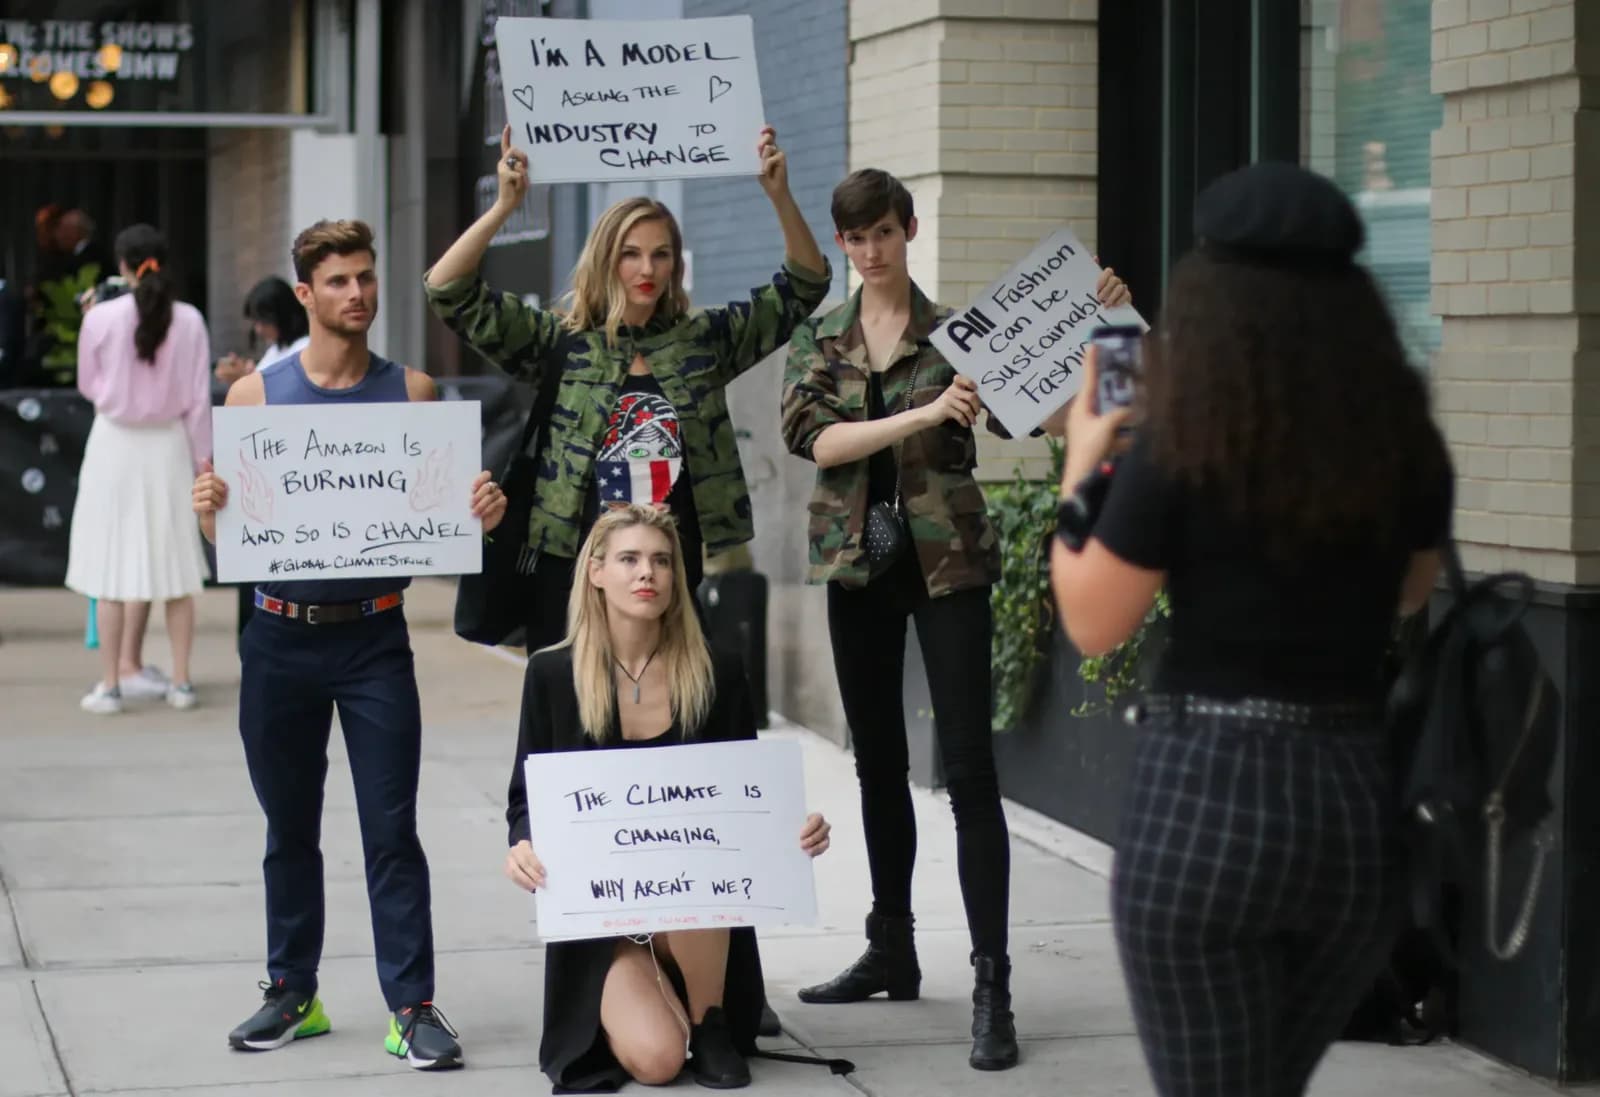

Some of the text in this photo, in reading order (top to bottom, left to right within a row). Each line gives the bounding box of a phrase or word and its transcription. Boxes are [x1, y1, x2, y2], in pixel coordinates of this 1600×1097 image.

[43, 21, 94, 47] THE
[102, 22, 193, 49] SHOWS
[585, 40, 605, 67] A
[622, 42, 741, 68] MODEL
[561, 84, 681, 108] ASKING THE
[526, 122, 716, 145] INDUSTRY TO
[600, 145, 730, 169] CHANGE
[947, 243, 1076, 353] All Fashion
[1032, 289, 1069, 313] be
[981, 292, 1104, 393] Sustainabl
[240, 428, 423, 461] THE AMAZON IS
[280, 470, 408, 495] BURNING
[241, 517, 473, 546] AND SO IS CHANEL
[564, 784, 762, 813] THE CLIMATE IS
[614, 827, 720, 846] CHANGING,
[590, 871, 752, 902] WHY AREN'T WE?
